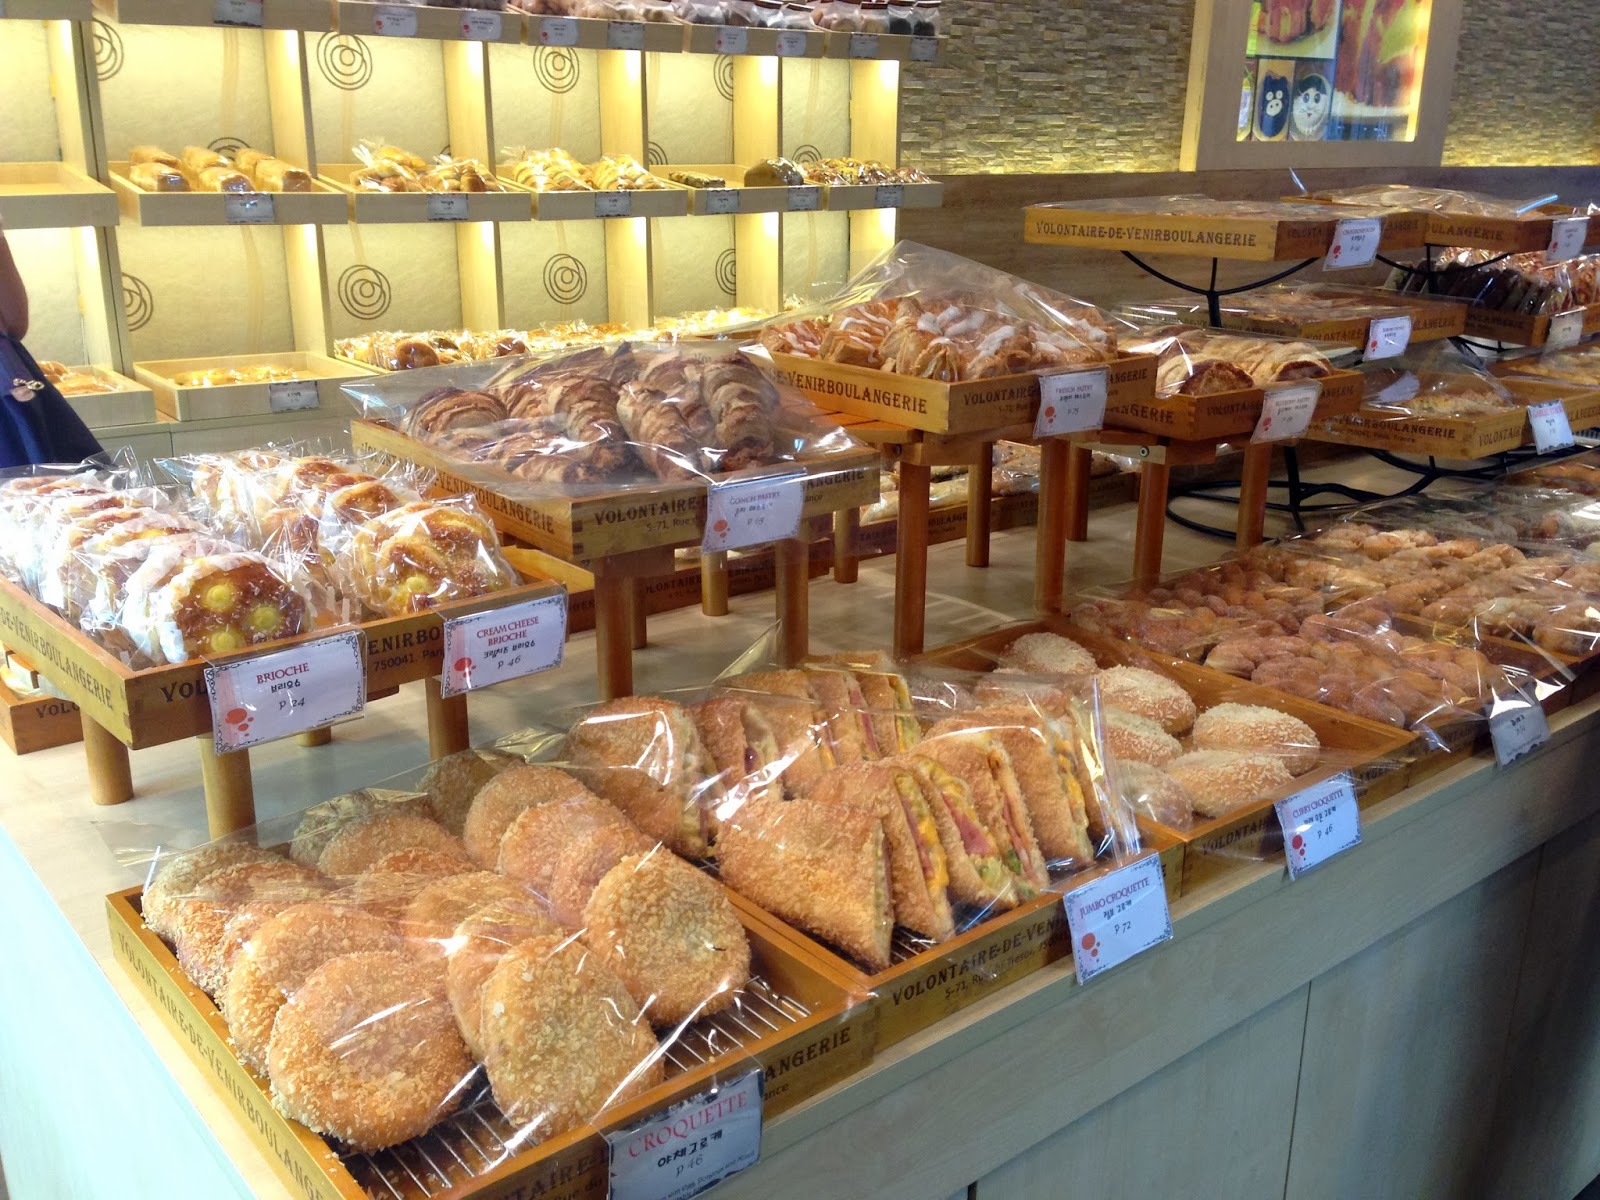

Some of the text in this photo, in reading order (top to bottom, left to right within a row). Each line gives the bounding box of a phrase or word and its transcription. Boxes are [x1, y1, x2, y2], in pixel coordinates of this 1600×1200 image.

[1036, 221, 1258, 247] VOLONTAIRE-DE-VENIRBOULANGERIE
[476, 615, 540, 639] CREAM CHEESE
[487, 629, 528, 647] BRIOCHE
[507, 654, 521, 667] 46
[256, 662, 310, 685] BRIOCHE
[1292, 803, 1312, 819] CURRY
[1310, 788, 1345, 811] CROQUETTE
[1324, 823, 1334, 837] 46
[1079, 876, 1150, 920] JUMBO CROQUETTE
[1122, 920, 1132, 934] 72
[628, 1090, 749, 1158] CROQUETTE
[686, 1153, 704, 1171] 46
